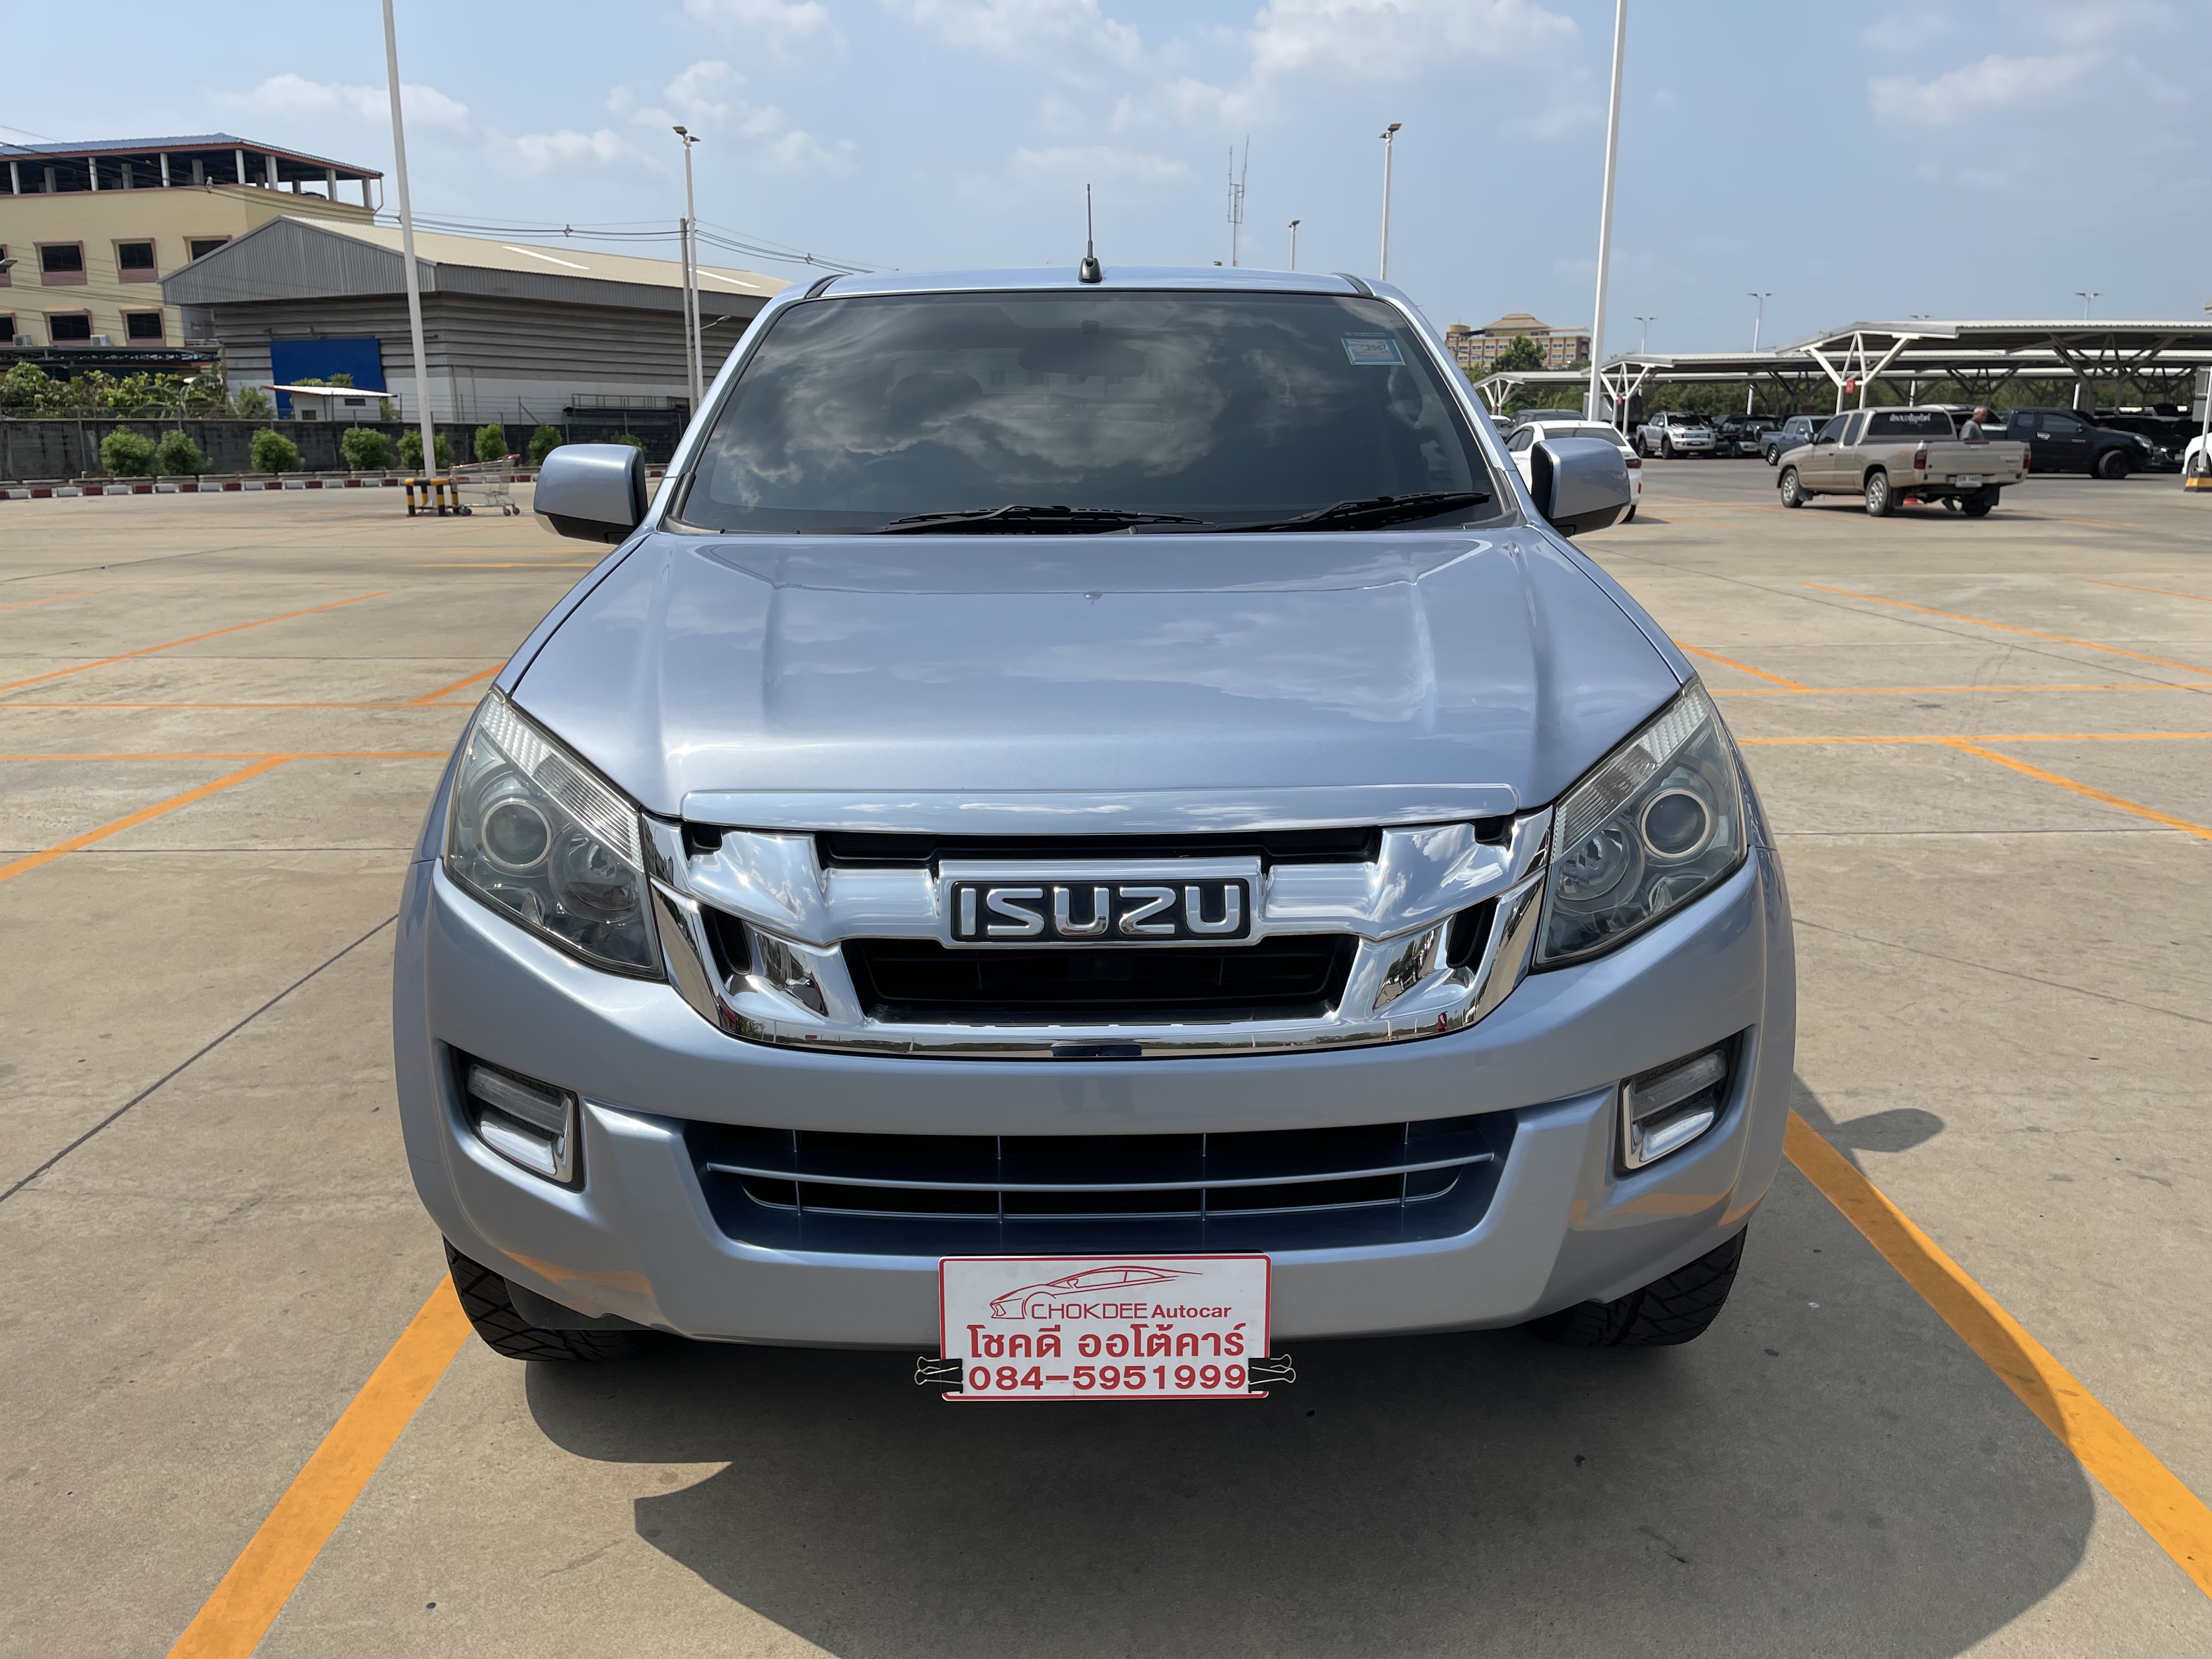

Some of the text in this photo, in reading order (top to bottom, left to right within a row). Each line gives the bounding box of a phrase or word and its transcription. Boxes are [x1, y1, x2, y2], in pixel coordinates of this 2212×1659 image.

[961, 885, 1240, 936] ISUZU
[1031, 1303, 1232, 1319] CHOKDEE Autocar
[967, 1322, 1246, 1358] โชคดี ออโต้คาร์
[968, 1363, 1246, 1391] 084-5951999
